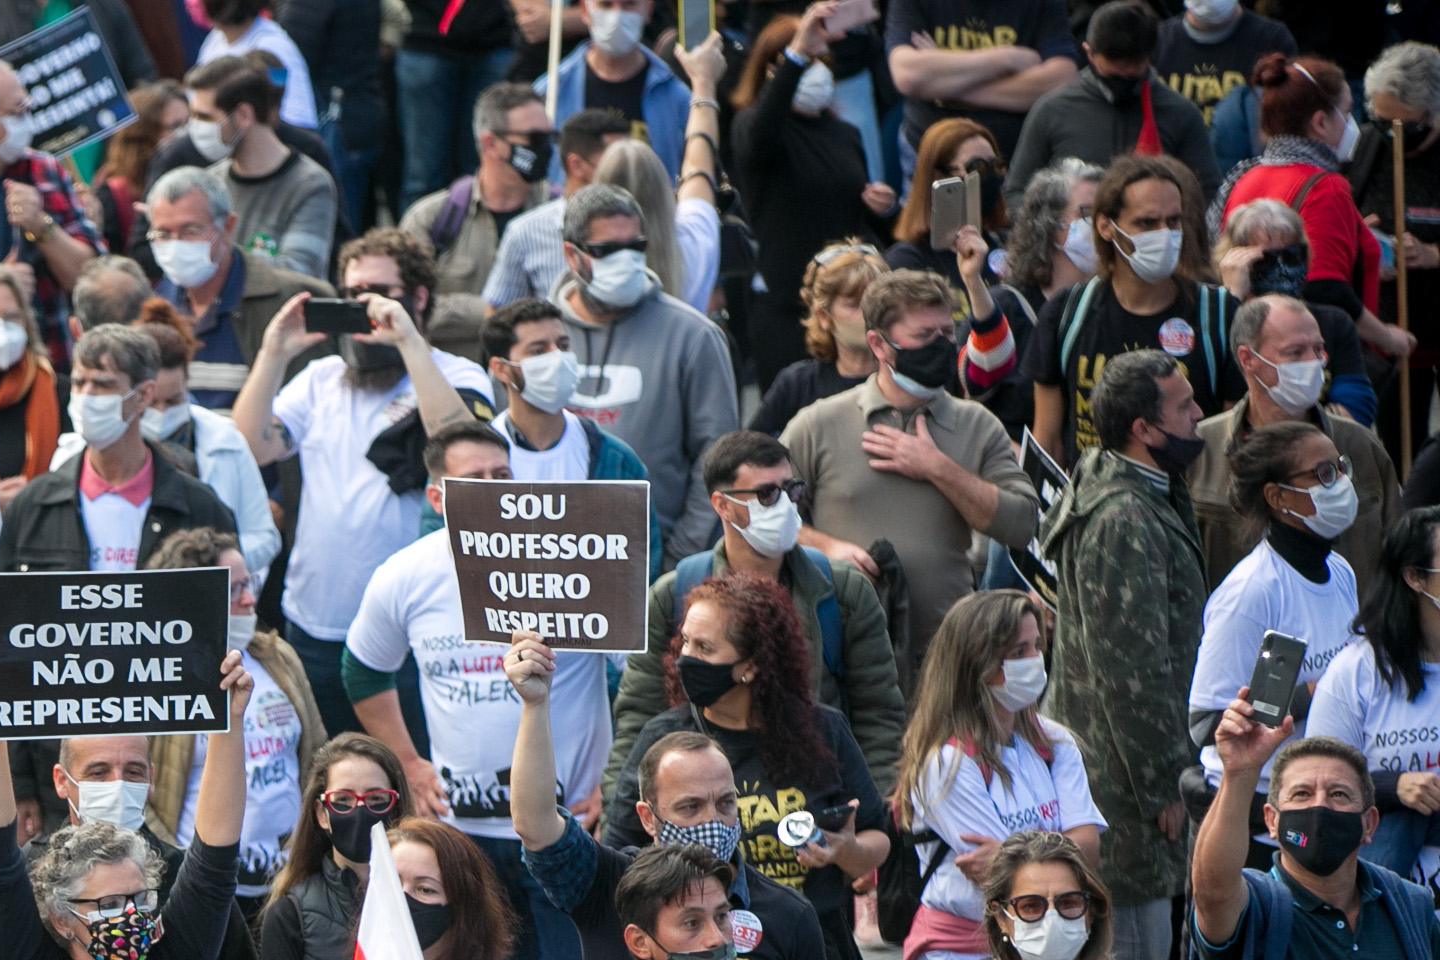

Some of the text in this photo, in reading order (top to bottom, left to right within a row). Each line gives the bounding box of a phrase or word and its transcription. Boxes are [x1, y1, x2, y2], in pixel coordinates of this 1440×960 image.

[500, 493, 566, 520] SOU
[459, 530, 629, 560] PROFESSOR
[61, 584, 143, 610] ESSE
[489, 571, 591, 602] QUERO
[9, 620, 193, 648] GOVERNO
[484, 607, 609, 639] RESPEITO
[32, 653, 183, 686] NÃO ME
[448, 657, 460, 674] A
[1375, 726, 1439, 748] NOSSOS
[1408, 752, 1421, 772] A
[1000, 806, 1039, 830] OSSOS
[744, 927, 758, 942] 32
